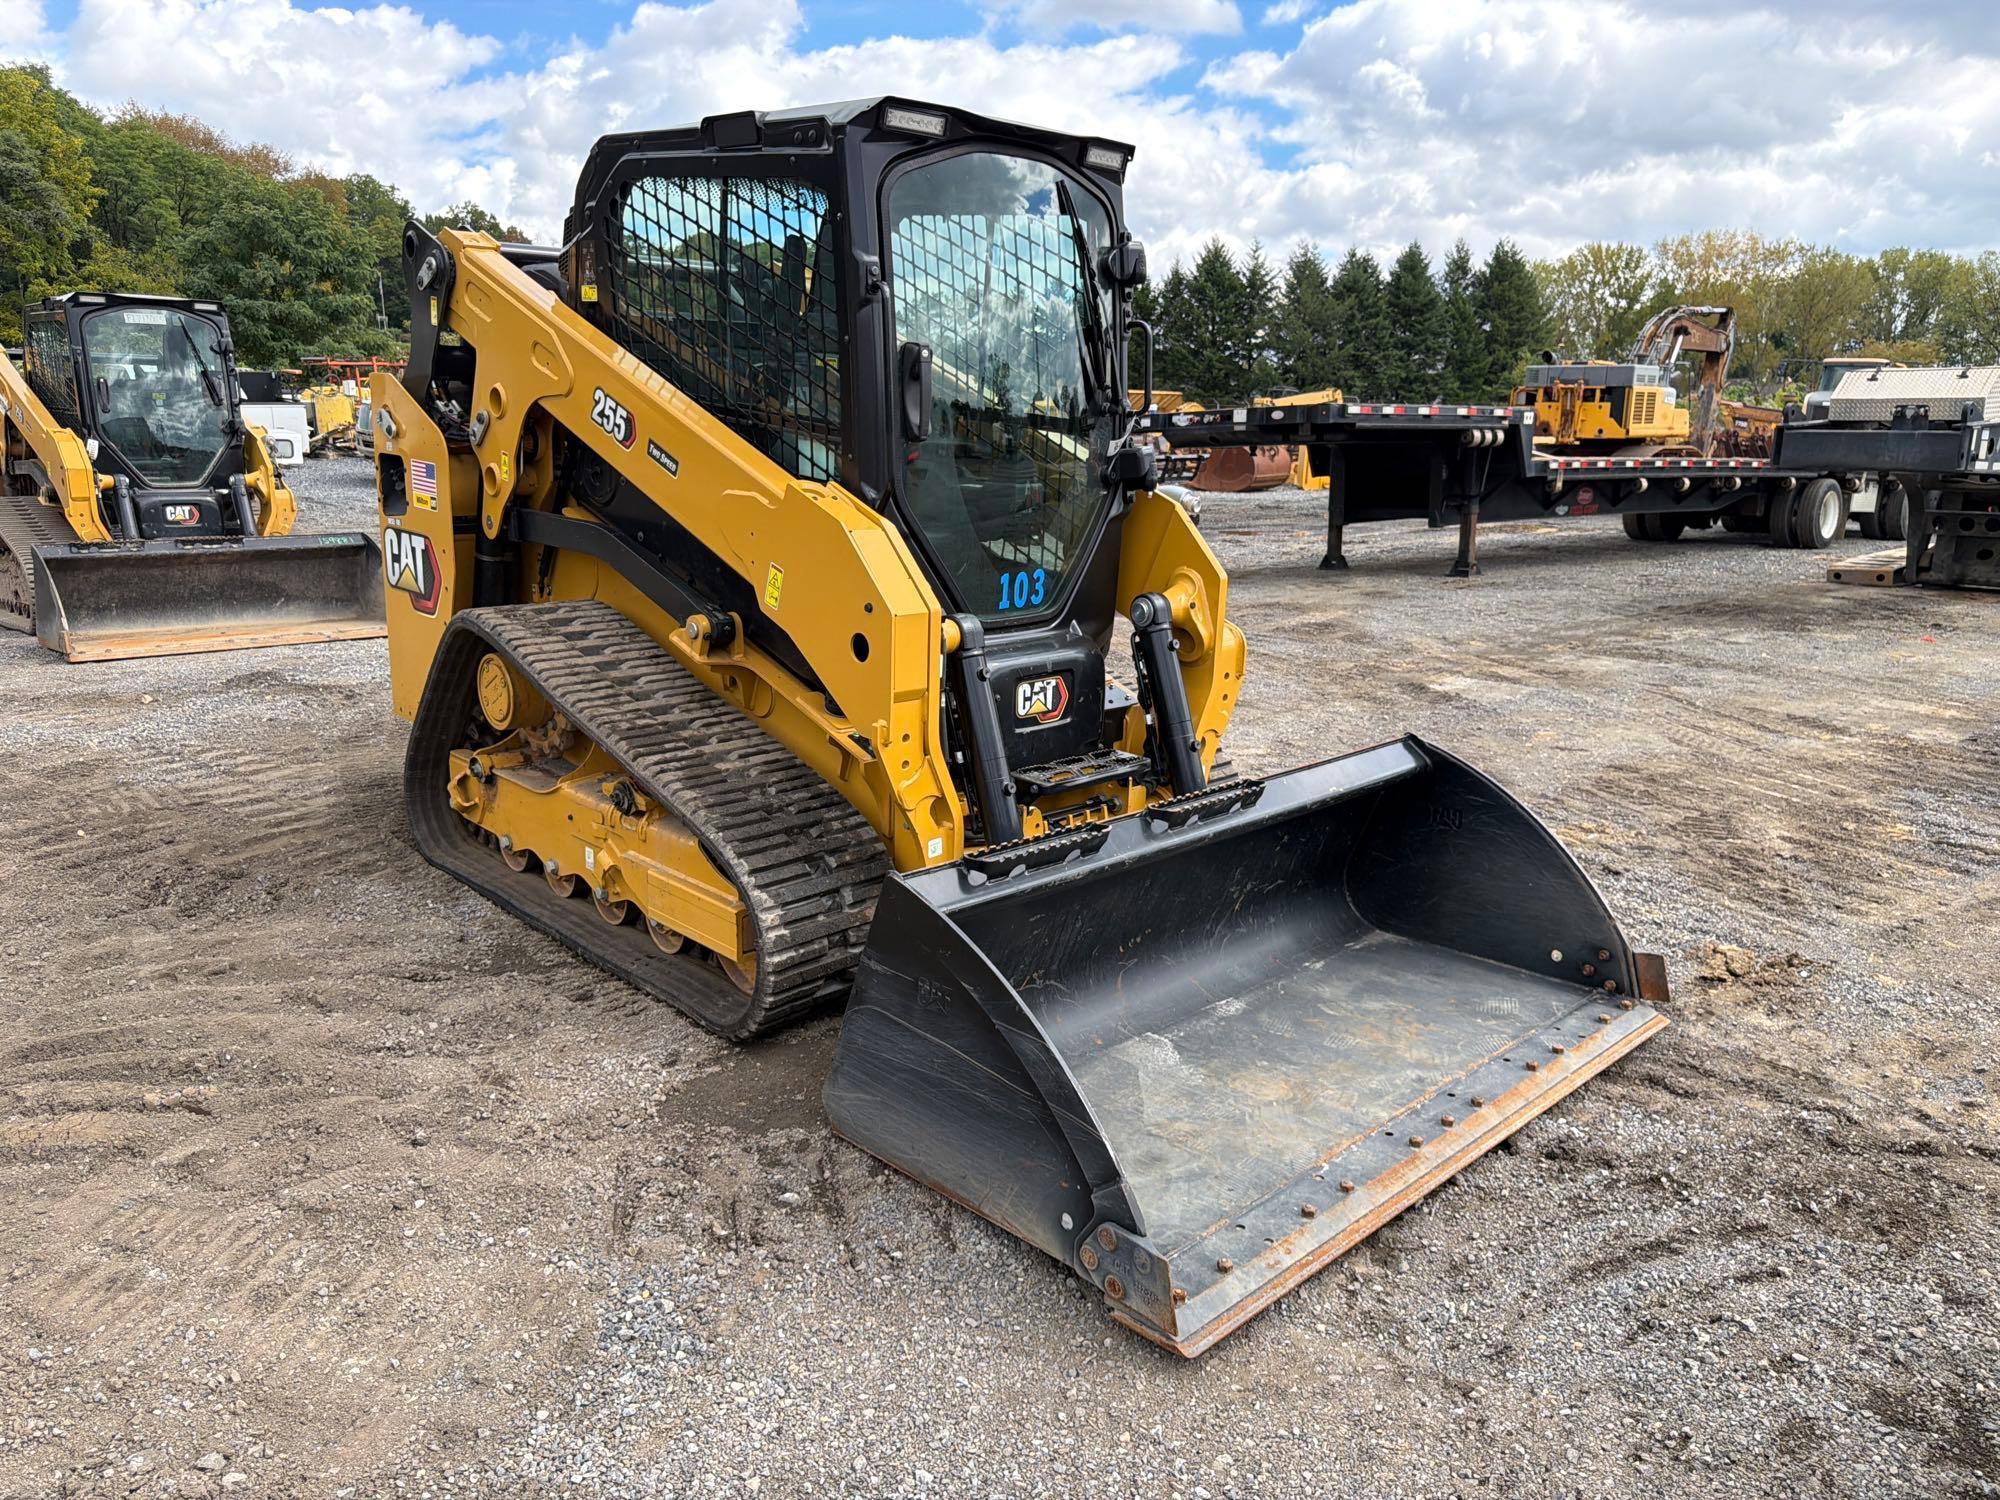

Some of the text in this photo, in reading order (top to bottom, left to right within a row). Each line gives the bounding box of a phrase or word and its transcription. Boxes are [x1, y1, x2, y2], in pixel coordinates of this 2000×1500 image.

[591, 388, 628, 441] 255
[165, 505, 191, 521] CAT
[384, 528, 426, 595] CAT
[999, 568, 1046, 610] 103
[1018, 678, 1057, 716] CAT
[1114, 1259, 1131, 1276] CAT
